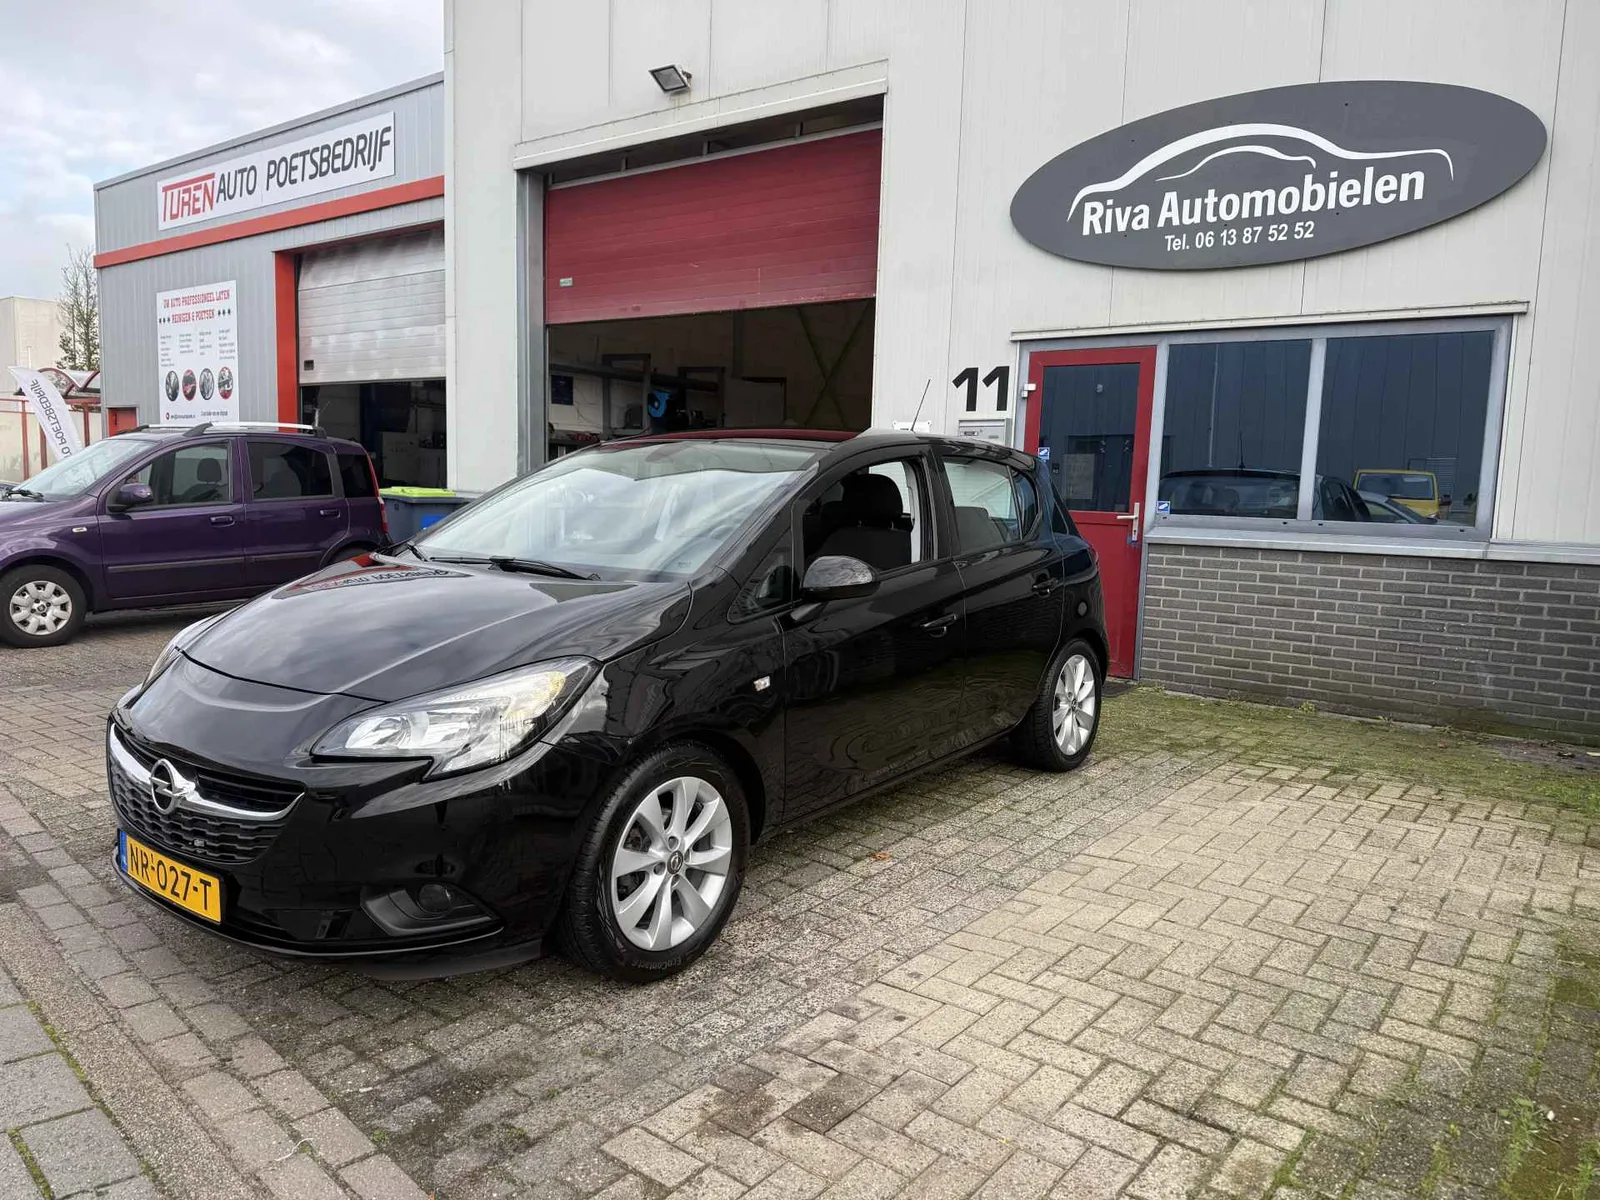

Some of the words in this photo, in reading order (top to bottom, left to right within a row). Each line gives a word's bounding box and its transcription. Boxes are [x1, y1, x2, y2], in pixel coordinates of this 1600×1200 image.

[162, 172, 216, 222] TUREN
[216, 164, 258, 203] AUTO
[266, 126, 392, 192] POETSBEDRIJF
[1082, 198, 1150, 236] Riva
[1157, 166, 1425, 228] Automobielen
[1165, 235, 1191, 252] Tel.
[1195, 231, 1215, 249] 06
[1220, 228, 1237, 247] 13
[1242, 226, 1260, 245] 87
[1267, 223, 1289, 242] 52
[1294, 221, 1315, 239] 52
[952, 365, 1010, 412] 11
[130, 843, 212, 911] NR-027-T
